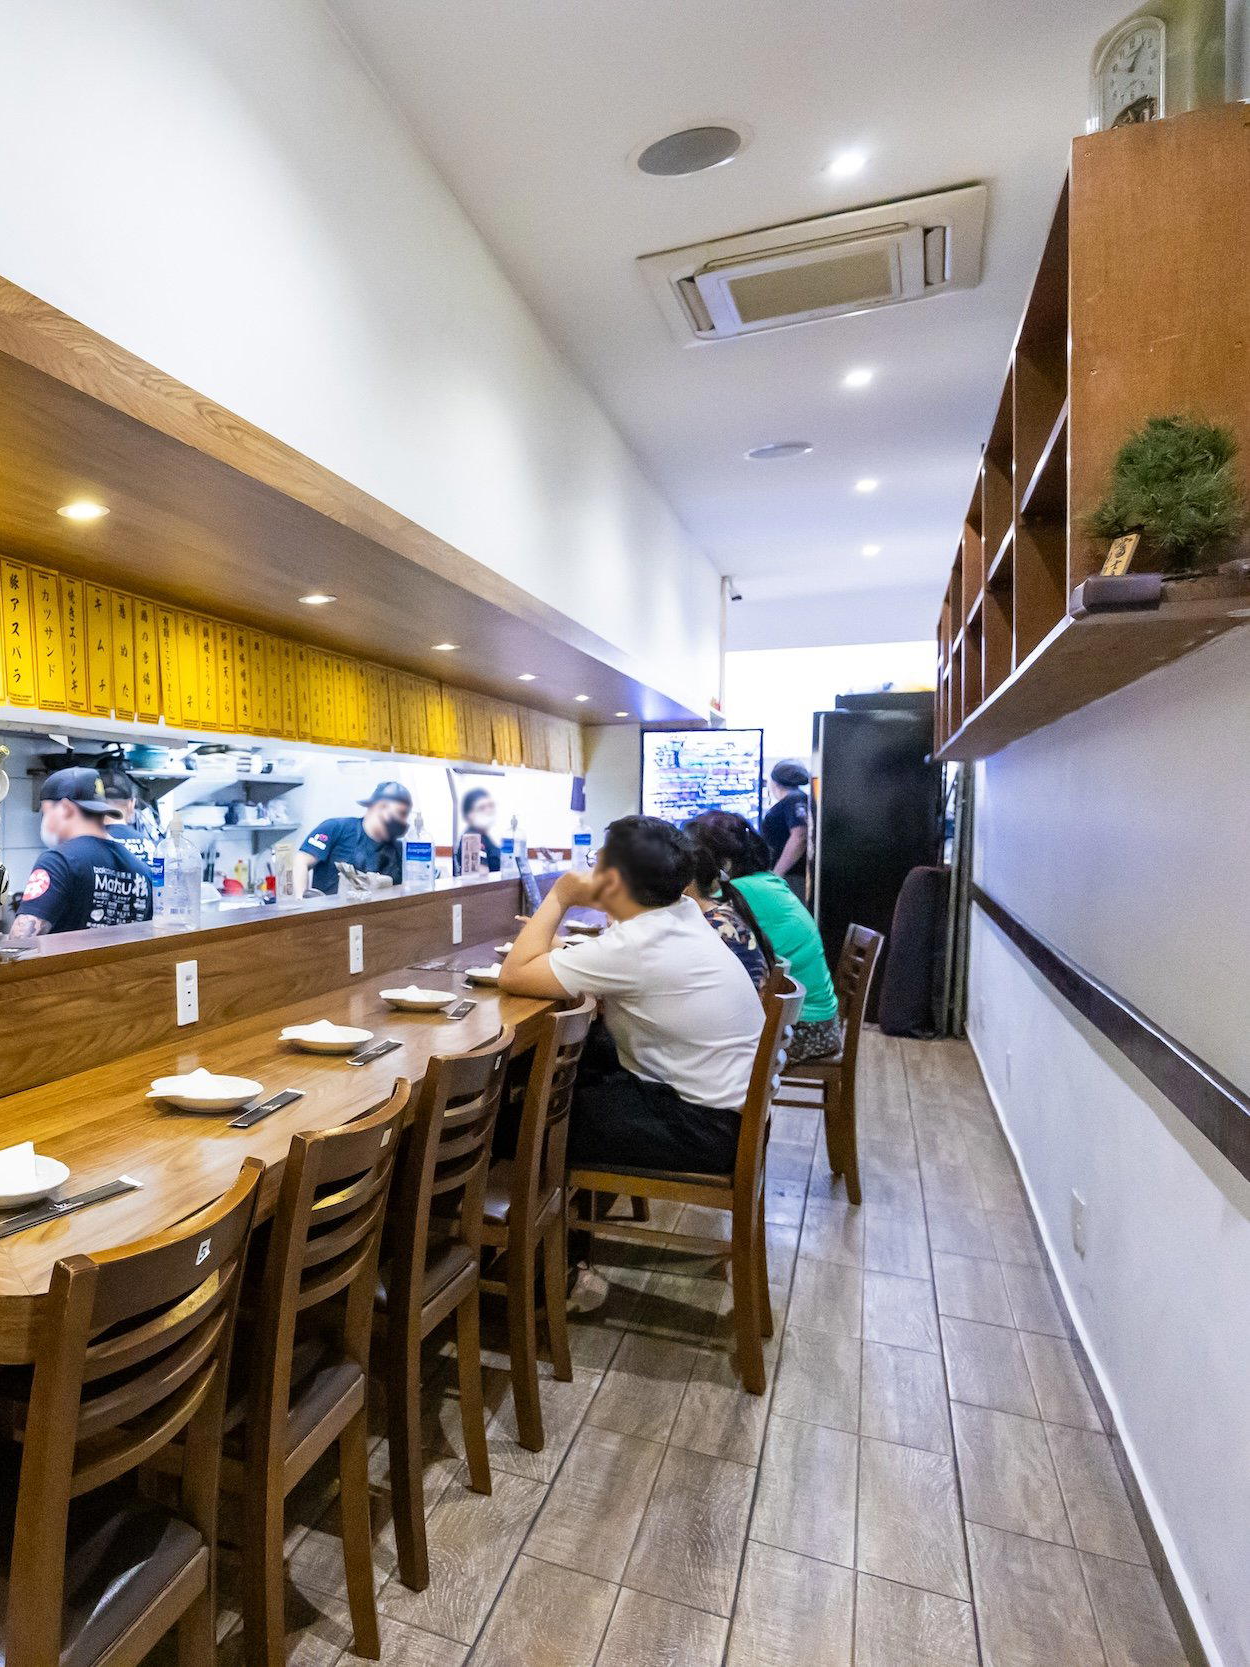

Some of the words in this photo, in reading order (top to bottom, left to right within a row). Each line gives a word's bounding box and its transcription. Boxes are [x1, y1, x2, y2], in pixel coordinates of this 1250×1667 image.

[41, 588, 55, 678] カツサンド
[94, 873, 132, 896] Matsu
